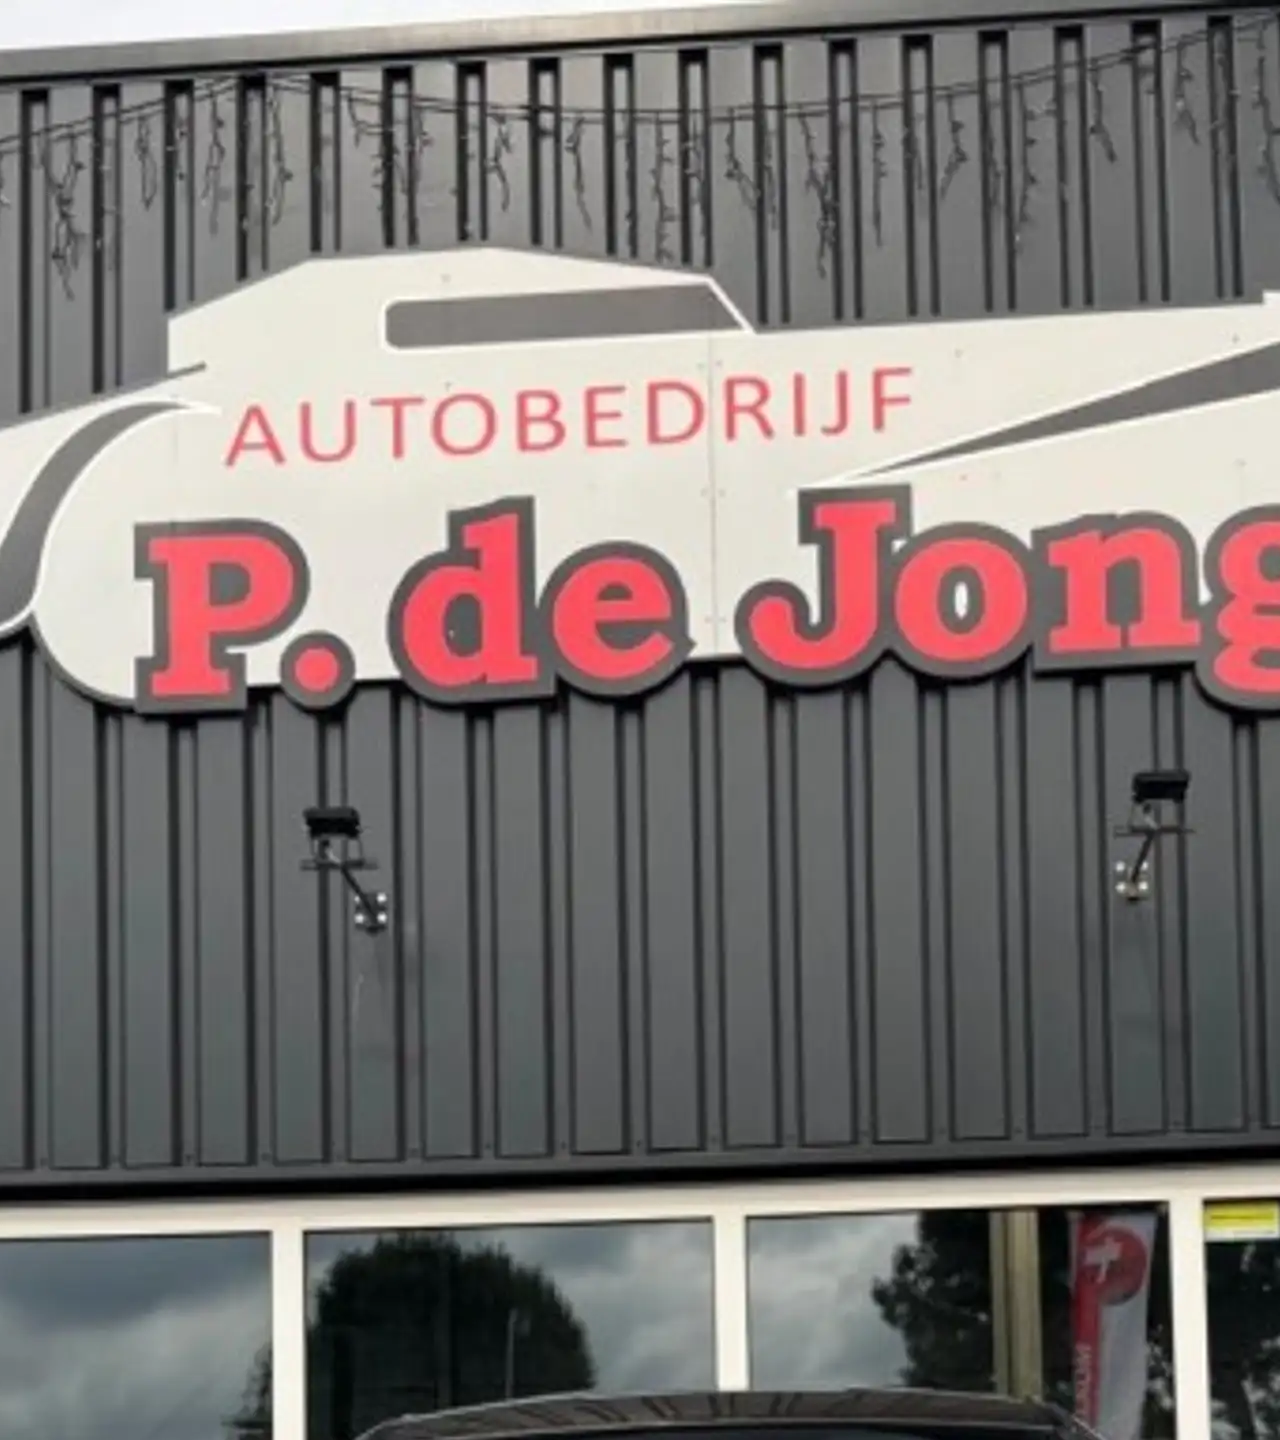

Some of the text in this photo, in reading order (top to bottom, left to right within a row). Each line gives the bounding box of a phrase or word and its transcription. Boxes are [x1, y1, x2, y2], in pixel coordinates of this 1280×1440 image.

[224, 366, 913, 467] AUTOBEDRIJF
[134, 518, 356, 710] P.
[388, 495, 696, 699] de
